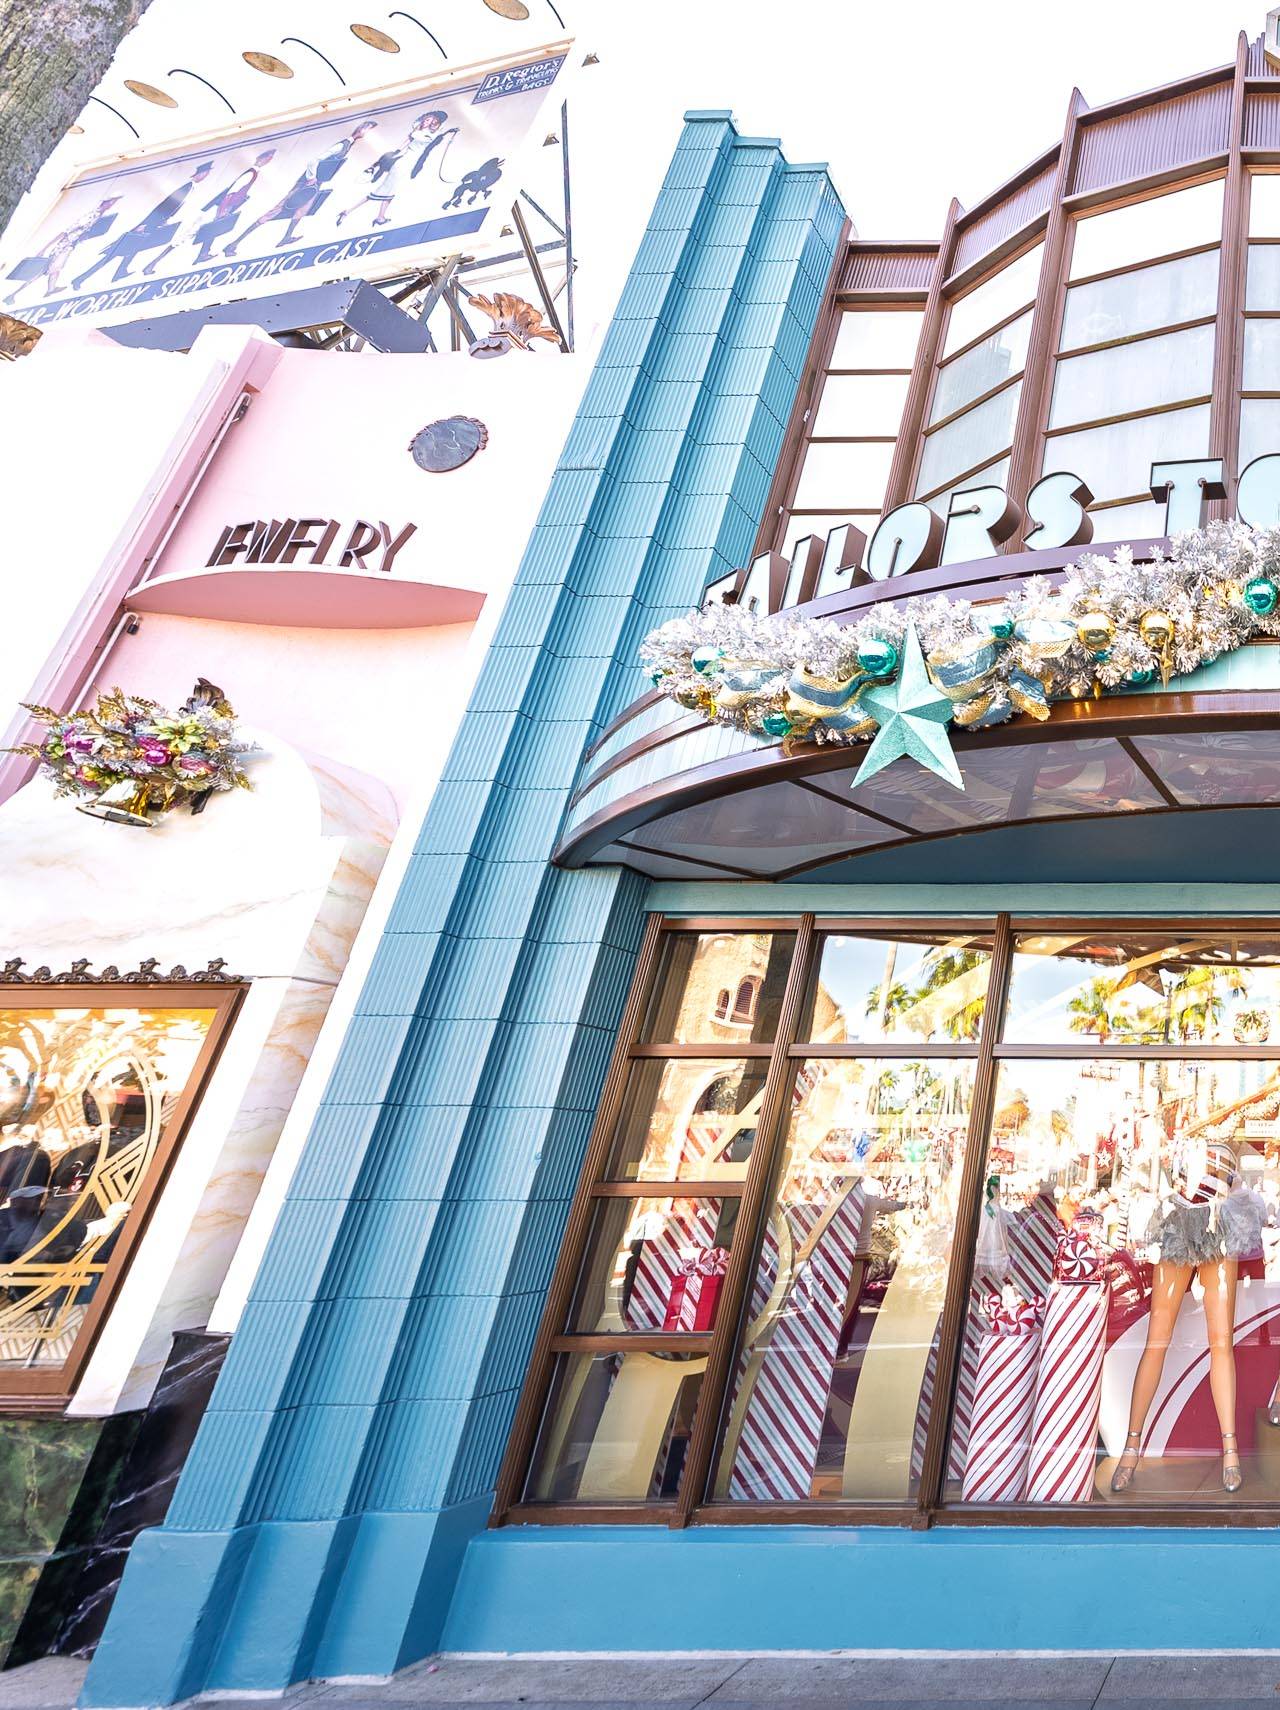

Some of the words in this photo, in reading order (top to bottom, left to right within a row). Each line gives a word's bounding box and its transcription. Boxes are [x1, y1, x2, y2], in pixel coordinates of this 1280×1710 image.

[10, 284, 150, 326] TAR-WORTHY
[151, 252, 305, 300] SUPPORTING
[313, 235, 384, 267] CAST
